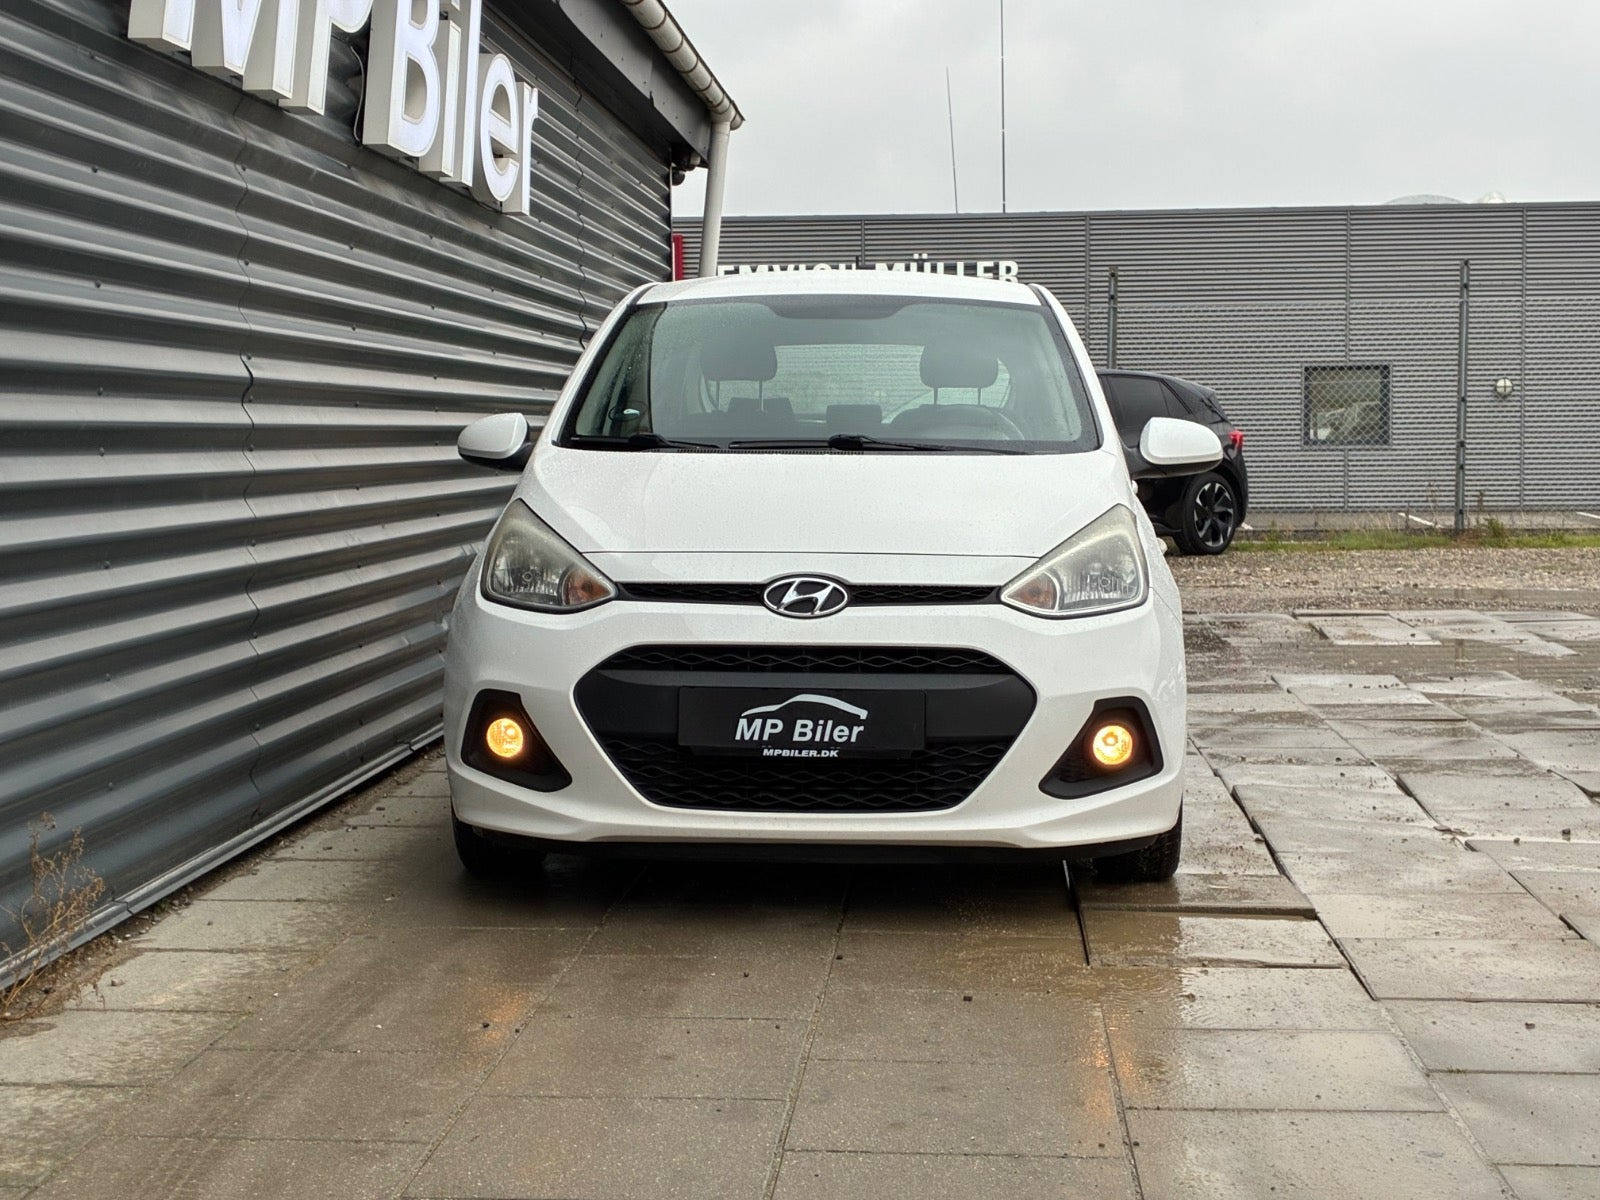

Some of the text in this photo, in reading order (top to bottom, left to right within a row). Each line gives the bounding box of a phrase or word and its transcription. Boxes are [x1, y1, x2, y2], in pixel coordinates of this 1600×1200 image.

[363, 0, 539, 216] Biler
[734, 718, 865, 743] MP Biler
[762, 748, 839, 758] MPBILER.DK
